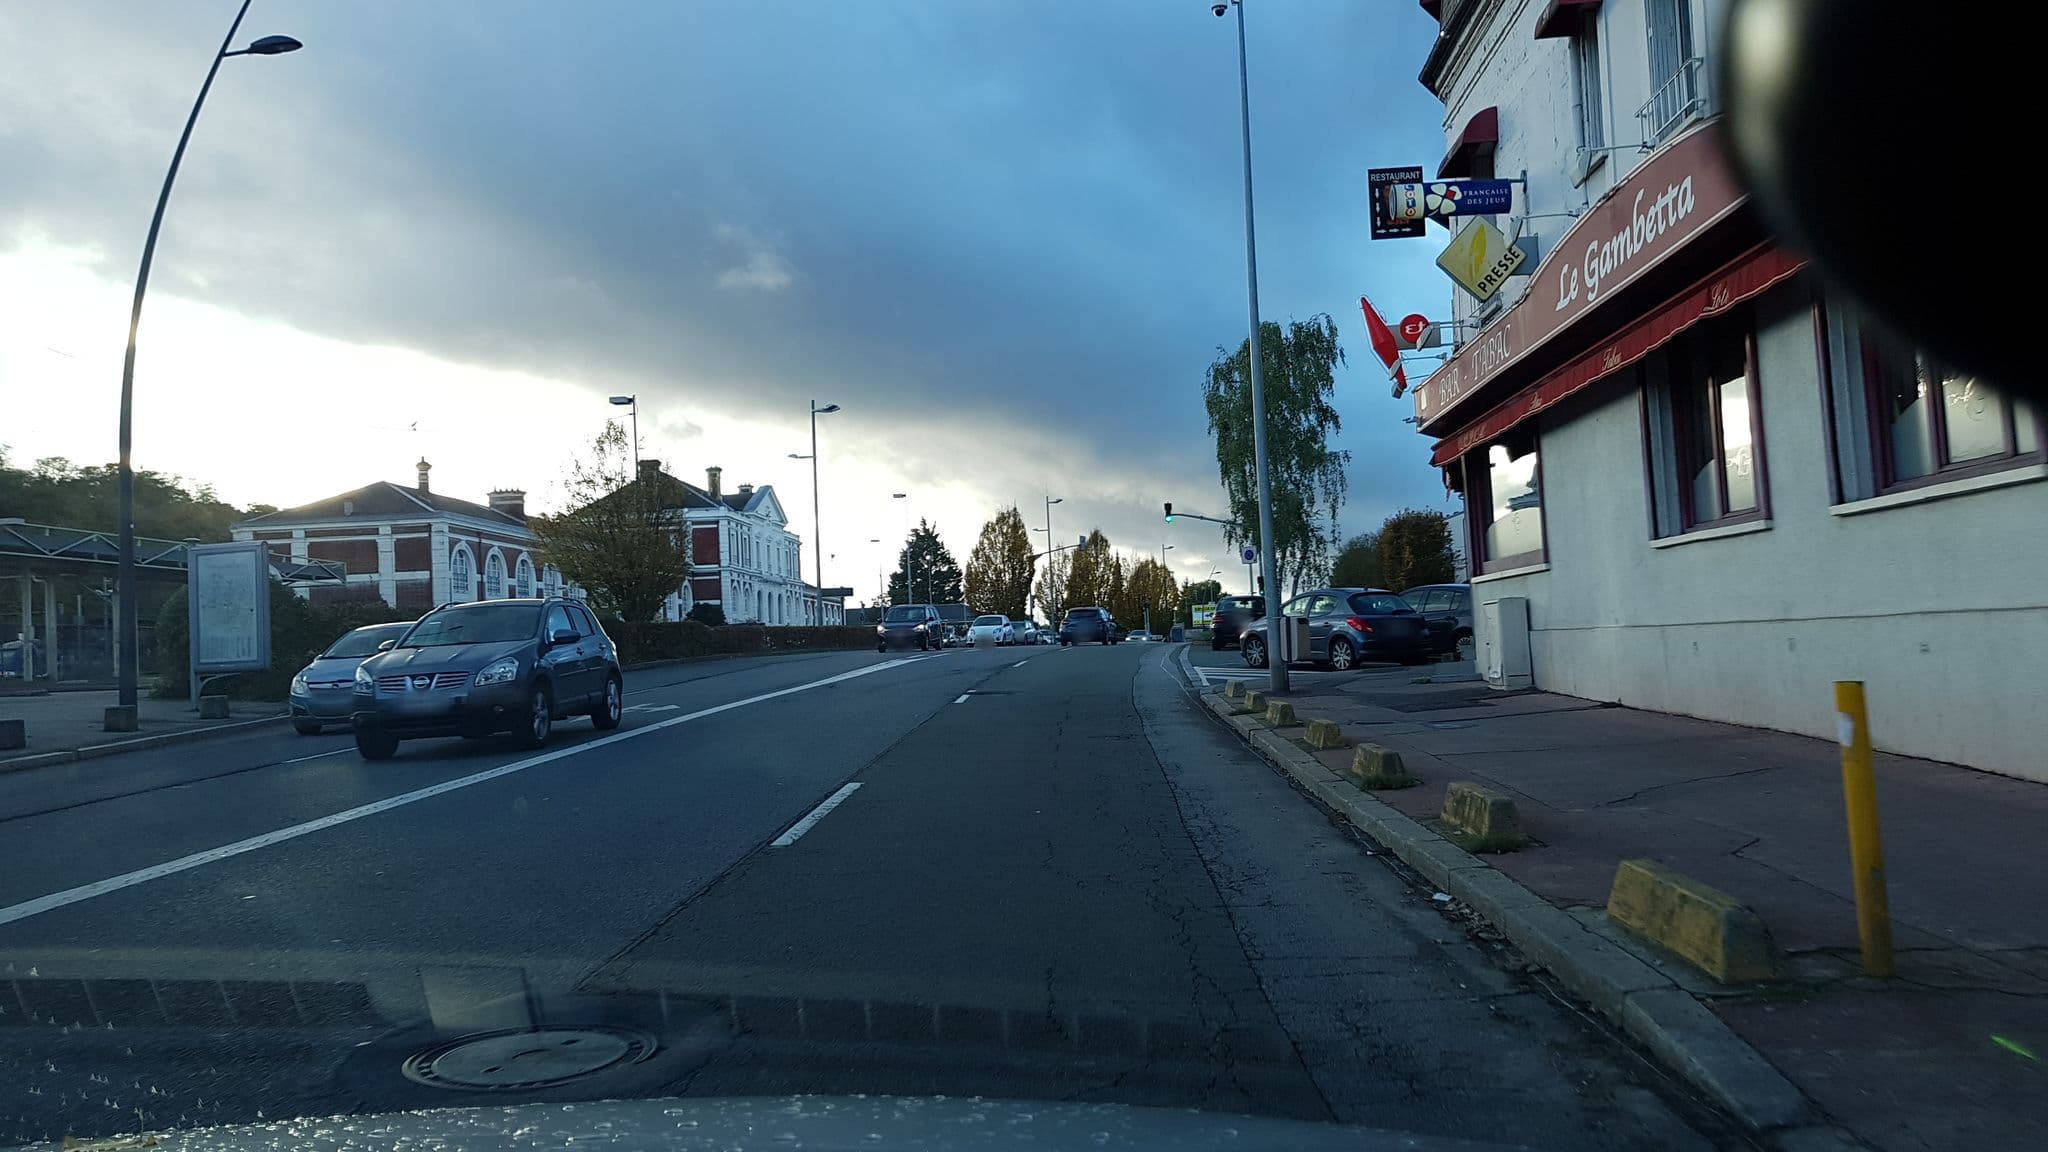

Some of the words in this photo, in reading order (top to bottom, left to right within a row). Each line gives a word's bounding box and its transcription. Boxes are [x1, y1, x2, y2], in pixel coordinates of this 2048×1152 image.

[1370, 171, 1421, 182] RESTAURANT
[1485, 197, 1506, 206] JEUX
[1555, 263, 1579, 312] Le
[1583, 175, 1695, 301] Gambetta
[1477, 248, 1521, 294] PRESSE
[1440, 366, 1460, 407] BAR
[1471, 323, 1512, 381] TABAC
